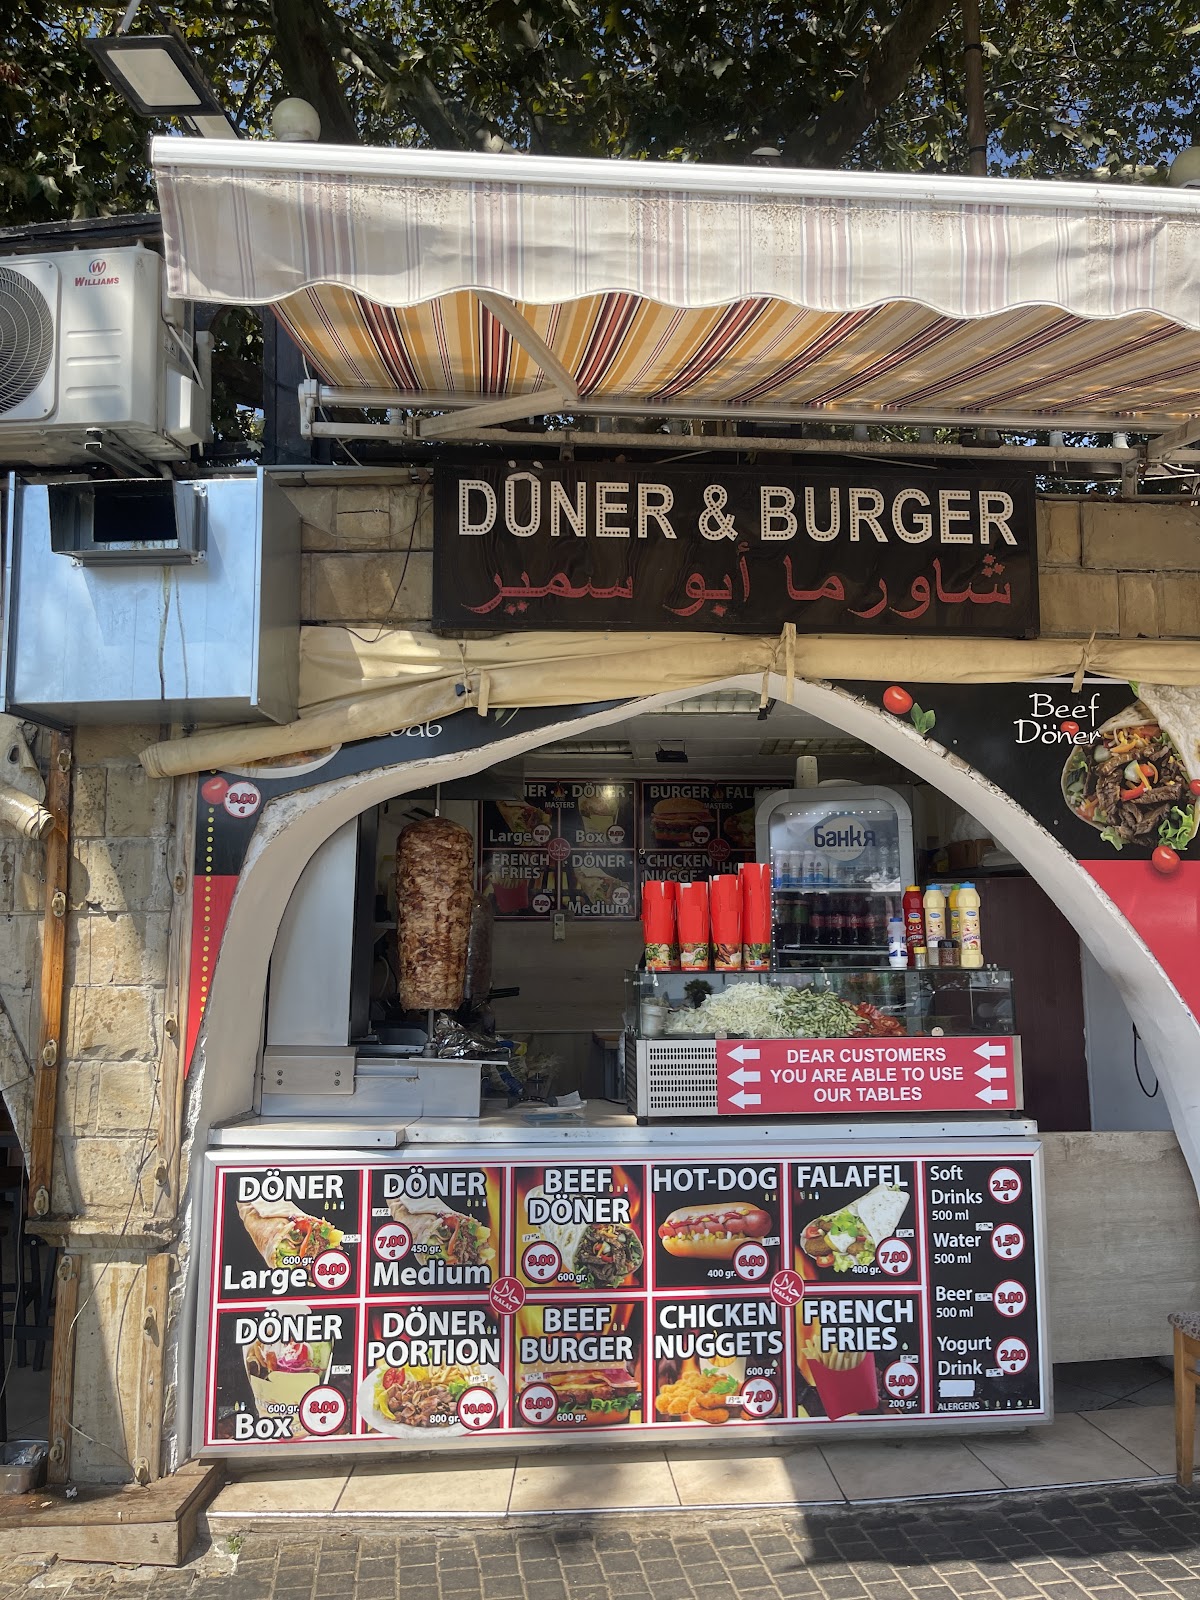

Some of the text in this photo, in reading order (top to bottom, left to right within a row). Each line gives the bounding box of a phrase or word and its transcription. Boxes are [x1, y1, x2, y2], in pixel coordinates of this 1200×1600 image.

[75, 277, 119, 287] WILLIAMS
[459, 460, 1018, 545] DÖNER & BURGER
[461, 571, 633, 614] سمير
[1029, 693, 1100, 727] Beef
[1013, 719, 1101, 744] Döner
[229, 793, 257, 804] 9.00
[650, 785, 709, 799] BURGER
[545, 801, 574, 809] MASTERS
[489, 829, 531, 845] Large
[575, 831, 604, 843] Box
[492, 854, 550, 866] FRENCH
[572, 852, 625, 868] DÖNER
[646, 854, 712, 868] CHICKEN
[501, 868, 540, 879] FRIES
[568, 901, 629, 914] Medium
[787, 1048, 946, 1063] DEAR CUSTOMERS
[770, 1066, 964, 1084] YOU ARE ABLE TO USE
[813, 1087, 922, 1102] OUR TABLES
[653, 1167, 778, 1192] HOT-DOG
[797, 1165, 908, 1188] FALAFEL
[930, 1166, 963, 1181] Soft
[238, 1169, 344, 1201] DÖNER
[383, 1167, 486, 1198] DÖNER
[545, 1169, 612, 1193] BEEF
[992, 1179, 1018, 1191] 2.50
[931, 1189, 982, 1205] Drinks
[529, 1194, 630, 1223] DÖNER
[932, 1210, 969, 1221] 500 ml
[377, 1235, 407, 1248] 7.00
[933, 1232, 981, 1248] Water
[995, 1234, 1020, 1246] 1.50
[411, 1245, 425, 1253] 450
[283, 1256, 300, 1265] 600
[527, 1254, 556, 1267] 9.00
[738, 1255, 765, 1267] 6.00
[881, 1251, 908, 1263] 7.00
[934, 1253, 971, 1264] 500 ml
[317, 1263, 346, 1276] 8.00
[373, 1260, 491, 1287] Medium
[707, 1269, 723, 1278] 400
[852, 1266, 868, 1274] 400
[224, 1265, 308, 1294] Large
[557, 1272, 573, 1282] 600
[773, 1287, 792, 1303] HALAL
[935, 1286, 972, 1301] Beer
[998, 1292, 1023, 1303] 3.00
[493, 1295, 513, 1311] HALAL
[660, 1302, 777, 1329] CHICKEN
[803, 1300, 913, 1324] FRENCH
[936, 1307, 973, 1318] 500 ml
[383, 1306, 486, 1337] DÖNER
[544, 1307, 611, 1332] BEEF
[236, 1311, 343, 1345] DÖNER
[655, 1331, 783, 1358] NUGGETS
[821, 1327, 897, 1351] FRIES
[937, 1336, 992, 1354] Yogurt
[368, 1338, 500, 1367] PORTION
[521, 1336, 633, 1363] BURGER
[1000, 1349, 1026, 1361] 2.00
[747, 1367, 762, 1376] 600
[938, 1361, 982, 1376] Drink
[888, 1376, 915, 1387] 5.00
[525, 1397, 553, 1409] 8.00
[745, 1391, 773, 1403] 7.00
[889, 1399, 903, 1408] 200
[268, 1404, 285, 1413] 600
[309, 1401, 339, 1413] 8.00
[462, 1403, 493, 1414] 10.00
[937, 1401, 980, 1411] ALERGENS
[429, 1415, 446, 1423] 800
[557, 1413, 572, 1422] 600
[236, 1414, 293, 1439] Box
